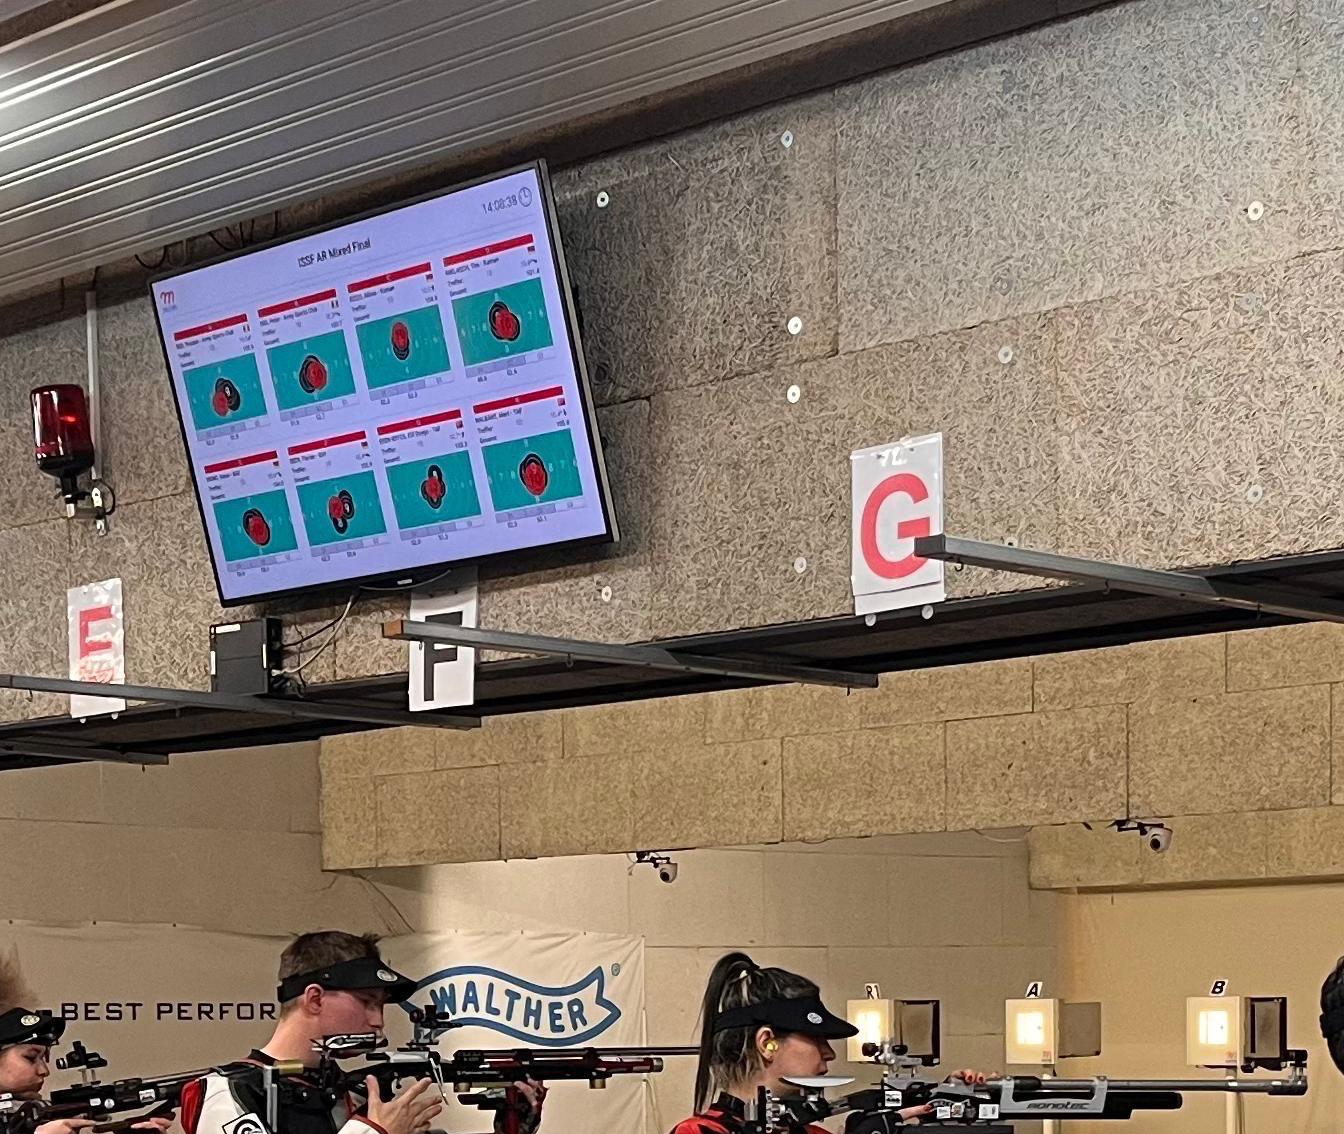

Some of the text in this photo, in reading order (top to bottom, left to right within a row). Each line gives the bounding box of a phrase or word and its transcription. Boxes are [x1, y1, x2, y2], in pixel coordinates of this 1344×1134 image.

[297, 237, 371, 268] ISSF AR Mixed Final
[860, 473, 931, 579] G
[80, 605, 115, 684] E
[423, 611, 464, 702] F
[865, 985, 880, 1000] R1
[1026, 983, 1039, 998] A
[1211, 980, 1226, 995] B
[61, 1002, 276, 1021] BEST PERFOR
[429, 980, 589, 1034] WALTHER
